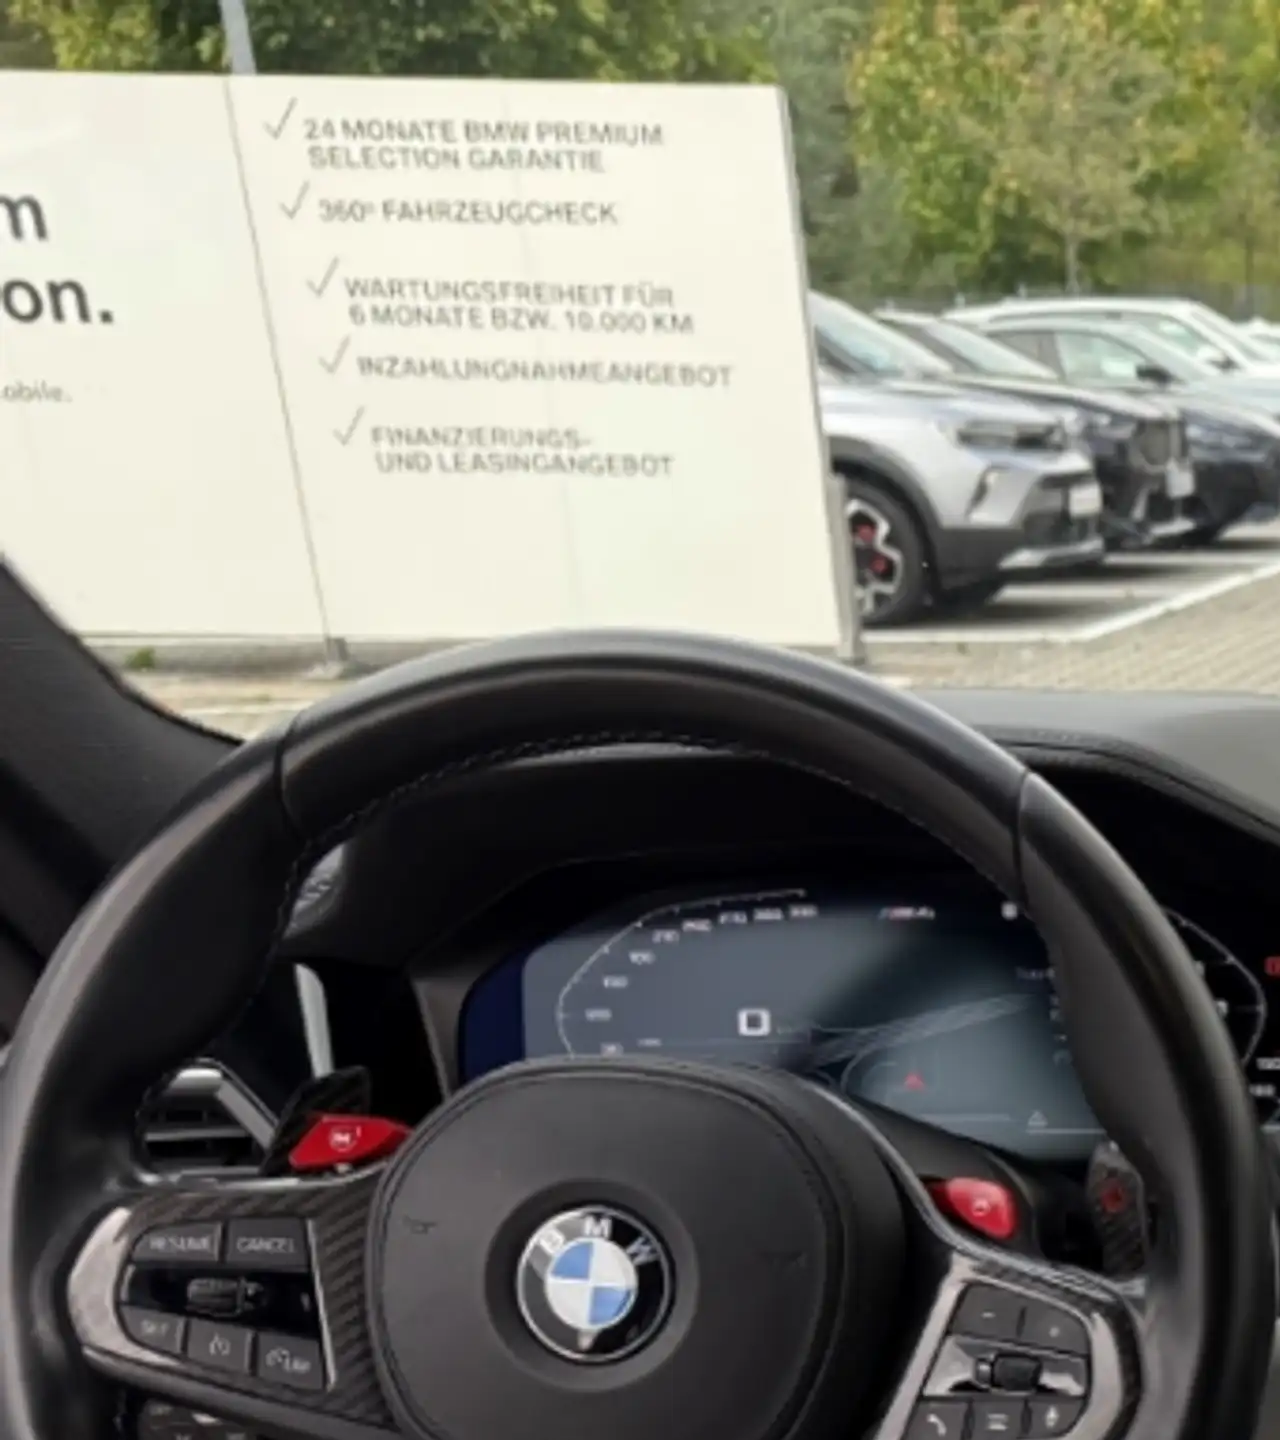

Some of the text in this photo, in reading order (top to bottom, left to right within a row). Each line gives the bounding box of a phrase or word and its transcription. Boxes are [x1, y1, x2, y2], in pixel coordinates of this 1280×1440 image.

[304, 118, 664, 146] 24 MONATE BMW PREMIUM
[307, 146, 606, 173] SELECTION GARANTIE
[381, 199, 618, 227] FAHRZEUGCHECK
[0, 277, 115, 326] on.
[344, 277, 675, 308] WARTUNGSFREIHEIT FÜR
[348, 304, 695, 335] 6 MONATE BZW. 10.000 KM
[357, 355, 733, 388] INZAHLUNGNAHMEANGEBOT
[369, 425, 594, 449] FINANZIERUNGS-
[375, 451, 676, 478] UND LEASINGANGEBOT
[236, 1235, 296, 1254] CANCEL
[537, 1214, 661, 1265] BMW
